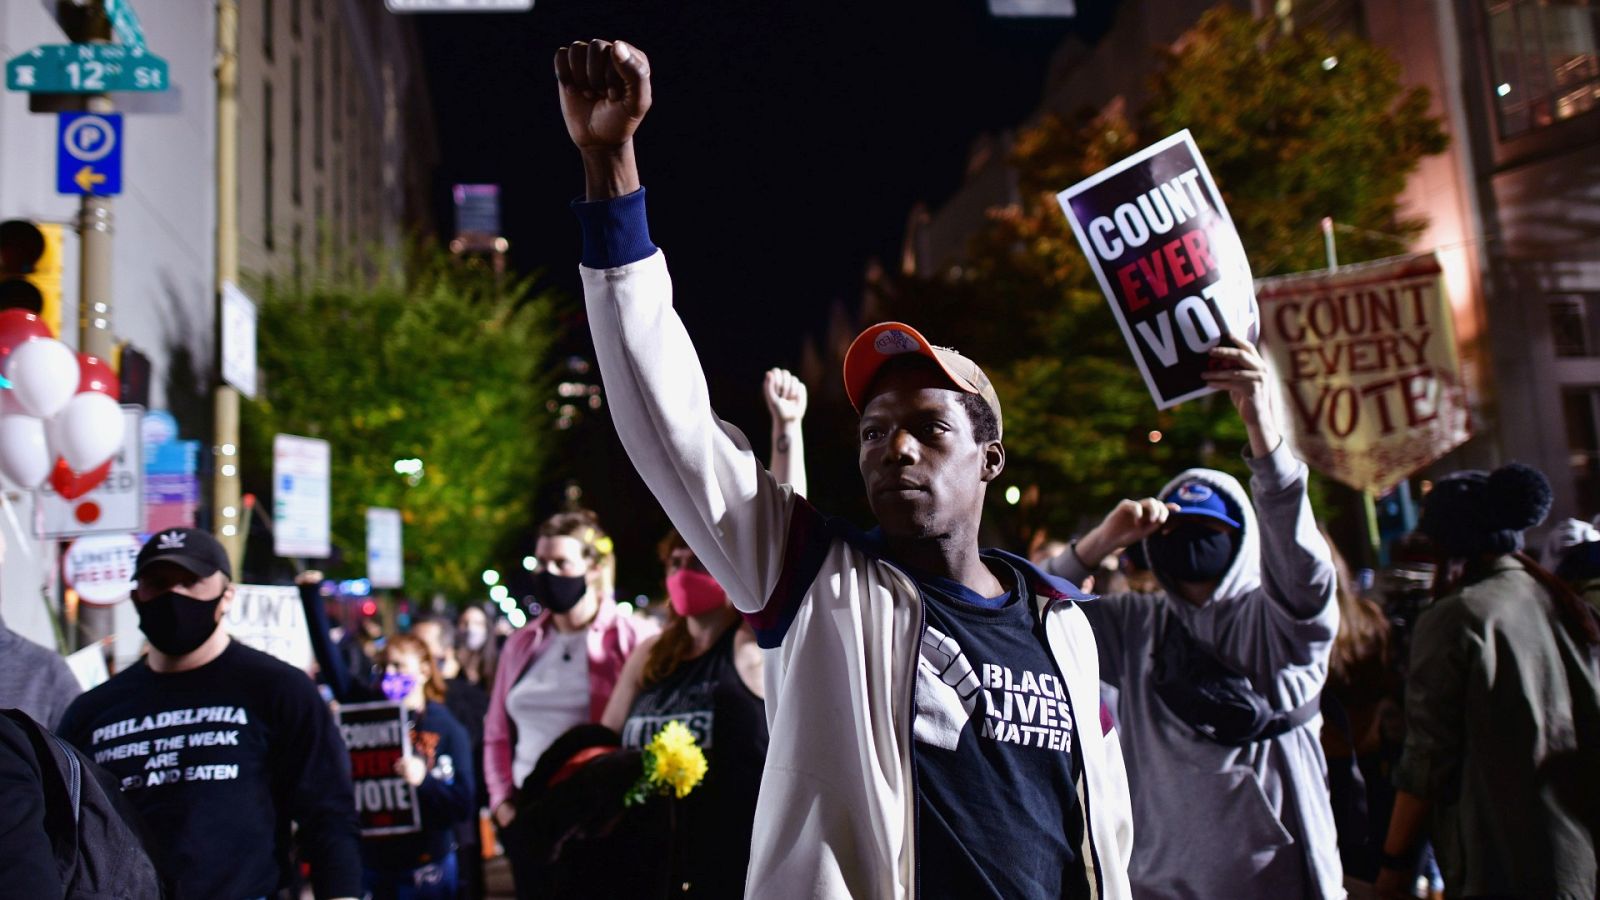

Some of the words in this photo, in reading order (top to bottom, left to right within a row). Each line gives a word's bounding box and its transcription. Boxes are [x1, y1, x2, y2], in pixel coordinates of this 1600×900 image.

[133, 66, 162, 88] St
[1088, 167, 1210, 262] COUNT
[1117, 222, 1222, 312] EVER
[1135, 278, 1236, 368] VOT
[1275, 280, 1435, 344] COUNT
[1288, 331, 1431, 383] EVERY
[1286, 369, 1438, 440] VOTE
[106, 470, 135, 494] ED
[227, 592, 298, 628] OUNT
[983, 663, 1067, 701] BLACK
[92, 706, 248, 745] PHILADELPHIA
[984, 689, 1073, 731] LIVES
[94, 740, 150, 764] WHERE
[154, 734, 185, 753] THE
[188, 730, 239, 747] WEAK
[627, 715, 706, 746] LIS
[981, 717, 1072, 753] MATTER
[144, 752, 178, 770] ARE
[147, 769, 181, 787] AND
[184, 764, 239, 781] EATEN
